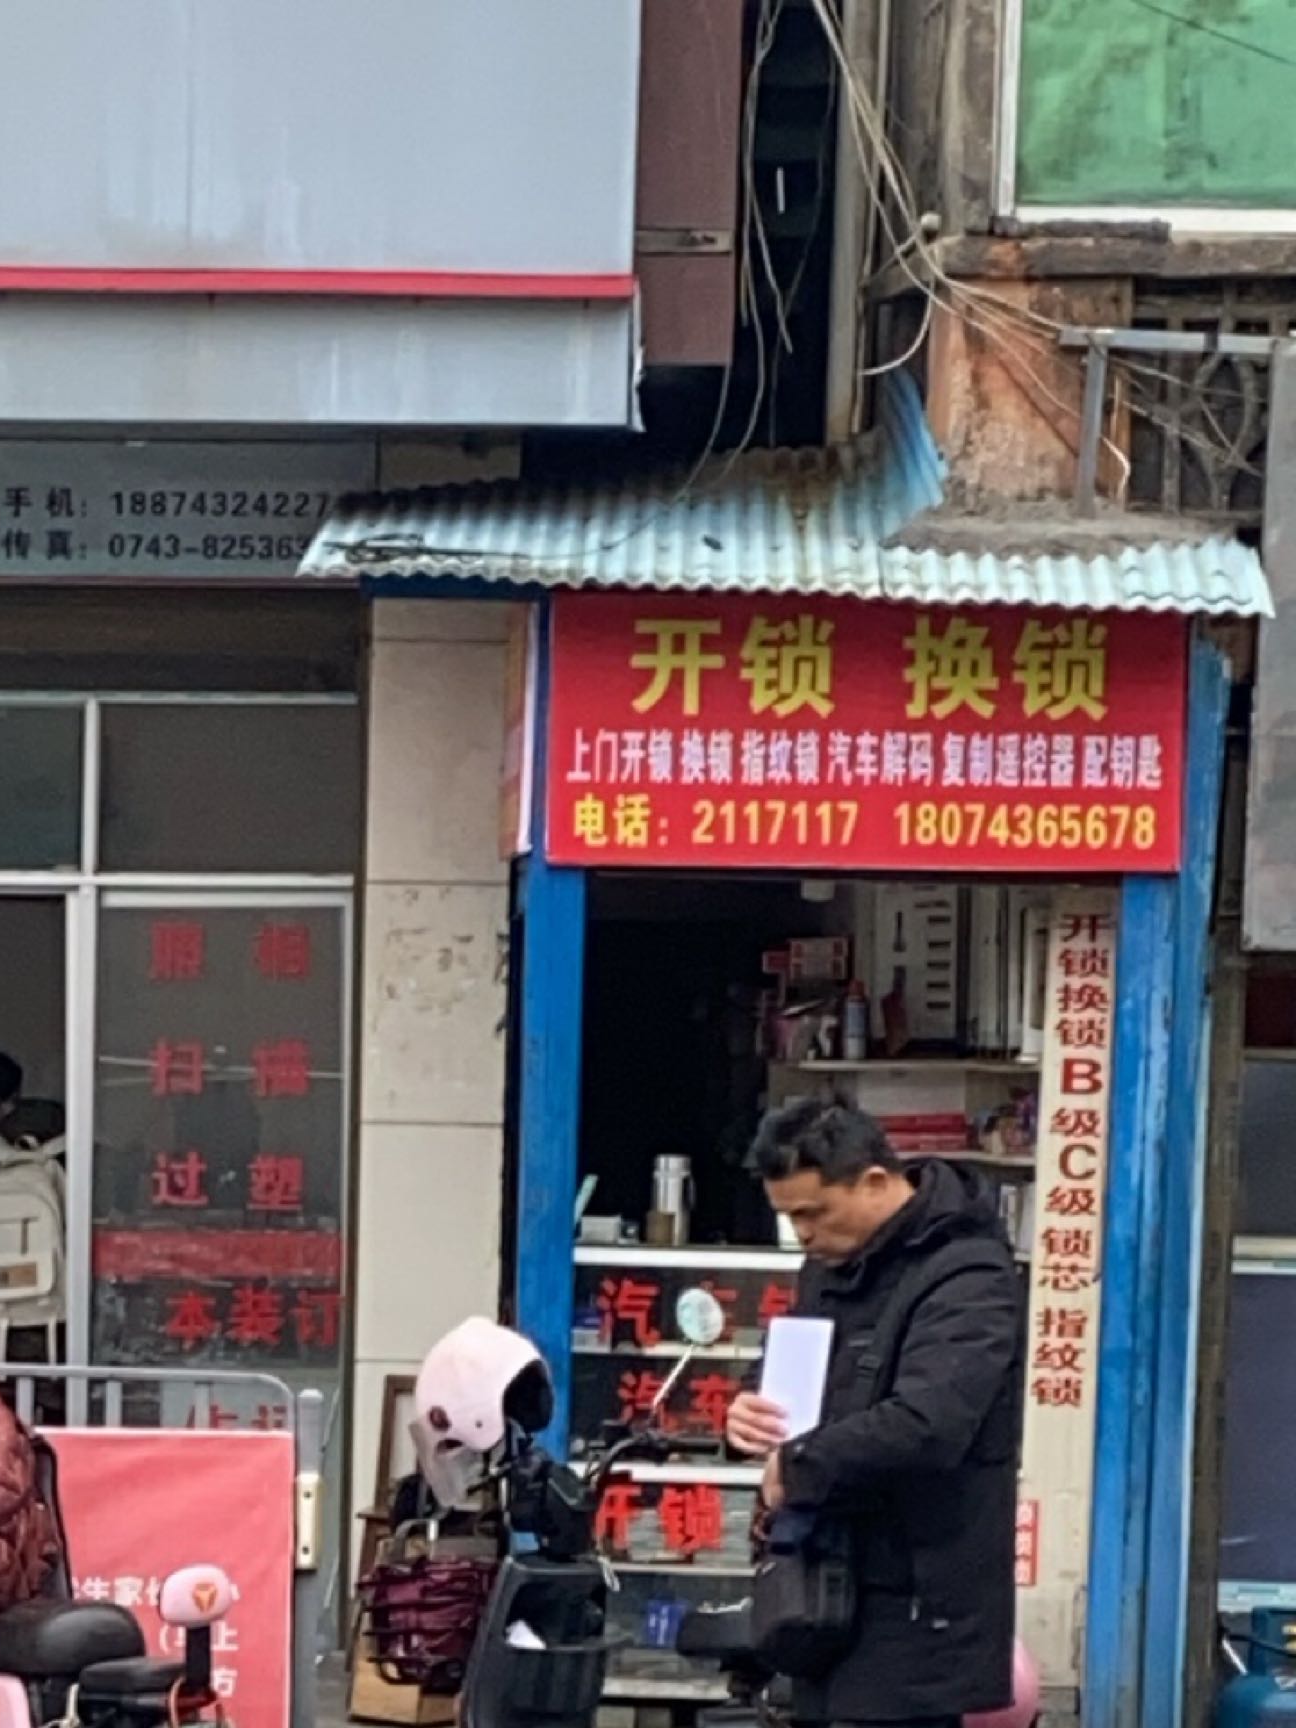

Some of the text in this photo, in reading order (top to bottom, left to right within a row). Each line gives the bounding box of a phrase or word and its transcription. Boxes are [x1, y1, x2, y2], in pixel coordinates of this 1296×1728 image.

[109, 490, 331, 518] 18874324227
[629, 614, 1109, 721] 开锁 换锁
[566, 727, 1161, 790] 上门开锁 换锁 指纹锁 汽车解码 复制遥控器 配钥匙
[573, 792, 1156, 850] 电话： 2117117 18074365678
